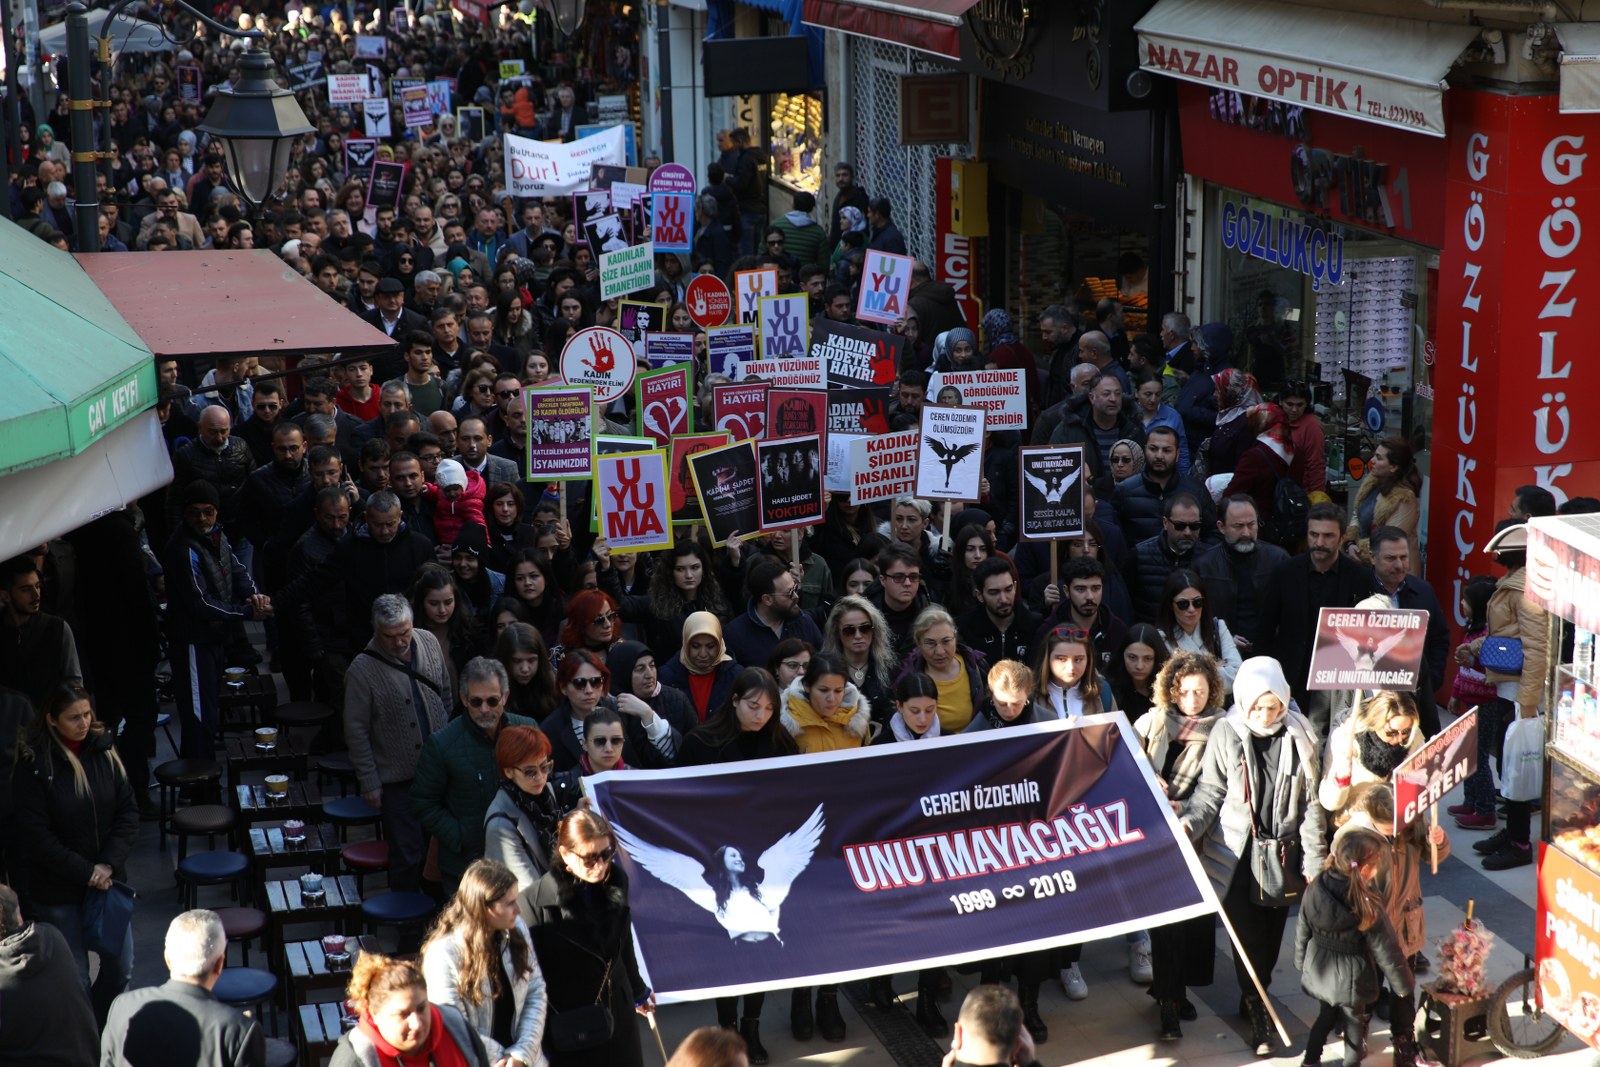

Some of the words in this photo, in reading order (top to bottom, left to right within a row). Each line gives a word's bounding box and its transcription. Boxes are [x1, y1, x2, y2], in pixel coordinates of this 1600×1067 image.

[1147, 43, 1239, 86] NAZAR
[1258, 67, 1348, 111] OPTİK
[1354, 85, 1362, 112] 1
[1072, 128, 1105, 155] Vermeyen
[511, 158, 560, 182] Dur!
[512, 181, 545, 192] Diyoruz
[665, 196, 679, 212] U
[658, 208, 686, 228] YU
[656, 226, 688, 244] MA
[1222, 196, 1344, 292] GÖZLÜKÇÜ
[607, 247, 645, 266] KADINLAR
[880, 256, 896, 276] U
[602, 268, 619, 283] SİZE
[620, 259, 652, 277] ALLAHIN
[604, 274, 650, 296] EMANETİDİR
[749, 274, 763, 293] U
[871, 272, 901, 294] YU
[774, 299, 790, 318] U
[865, 289, 900, 314] MA
[768, 316, 799, 337] YU
[766, 335, 804, 355] MA
[811, 341, 872, 367] ŞİDDETE
[827, 333, 877, 357] KADINA
[584, 370, 612, 379] KADIN
[745, 361, 776, 375] DÜNYA
[778, 360, 820, 372] YÜZÜNDE
[829, 360, 876, 382] HAYIR!
[570, 378, 608, 386] BEDENİNDEN
[647, 379, 682, 394] HAYIR!
[942, 373, 974, 386] DÜNYA
[975, 372, 1018, 384] YÜZÜNDE
[723, 393, 765, 404] HAYIR!
[963, 385, 1020, 398] GÖRDÜĞÜNÜZ
[88, 396, 107, 437] ÇAY
[112, 375, 139, 418] KEYFİ
[558, 406, 588, 416] ÖLDÜRÜLDÜ
[930, 412, 950, 420] CEREN
[950, 412, 977, 423] ÖZDEMİR
[986, 413, 1023, 426] SERİDİR
[932, 424, 974, 436] ÖLÜMSÜZDÜR!
[564, 447, 588, 455] KADINLAR
[866, 433, 920, 454] KADINA
[533, 457, 588, 470] İSYANIMIZDIR
[868, 449, 919, 470] ŞİDDET
[616, 458, 641, 485] U
[608, 483, 656, 512] YU
[771, 496, 790, 505] HAKLI
[791, 492, 813, 504] ŞİDDET
[767, 502, 818, 520] YOKTUR!
[607, 508, 664, 538] MA
[1327, 612, 1365, 628] CEREN
[1367, 611, 1421, 629] ÖZDEMİR
[1315, 667, 1339, 684] SENİ
[1339, 668, 1415, 685] UNUTMAYACAĞIZ
[919, 790, 972, 818] CEREN
[973, 778, 1041, 811] ÖZDEMİR
[1404, 757, 1468, 824] CEREN
[844, 798, 1144, 892] UNUTMAYACAĞIZ
[950, 888, 997, 916] 1999
[1029, 870, 1078, 900] 2019
